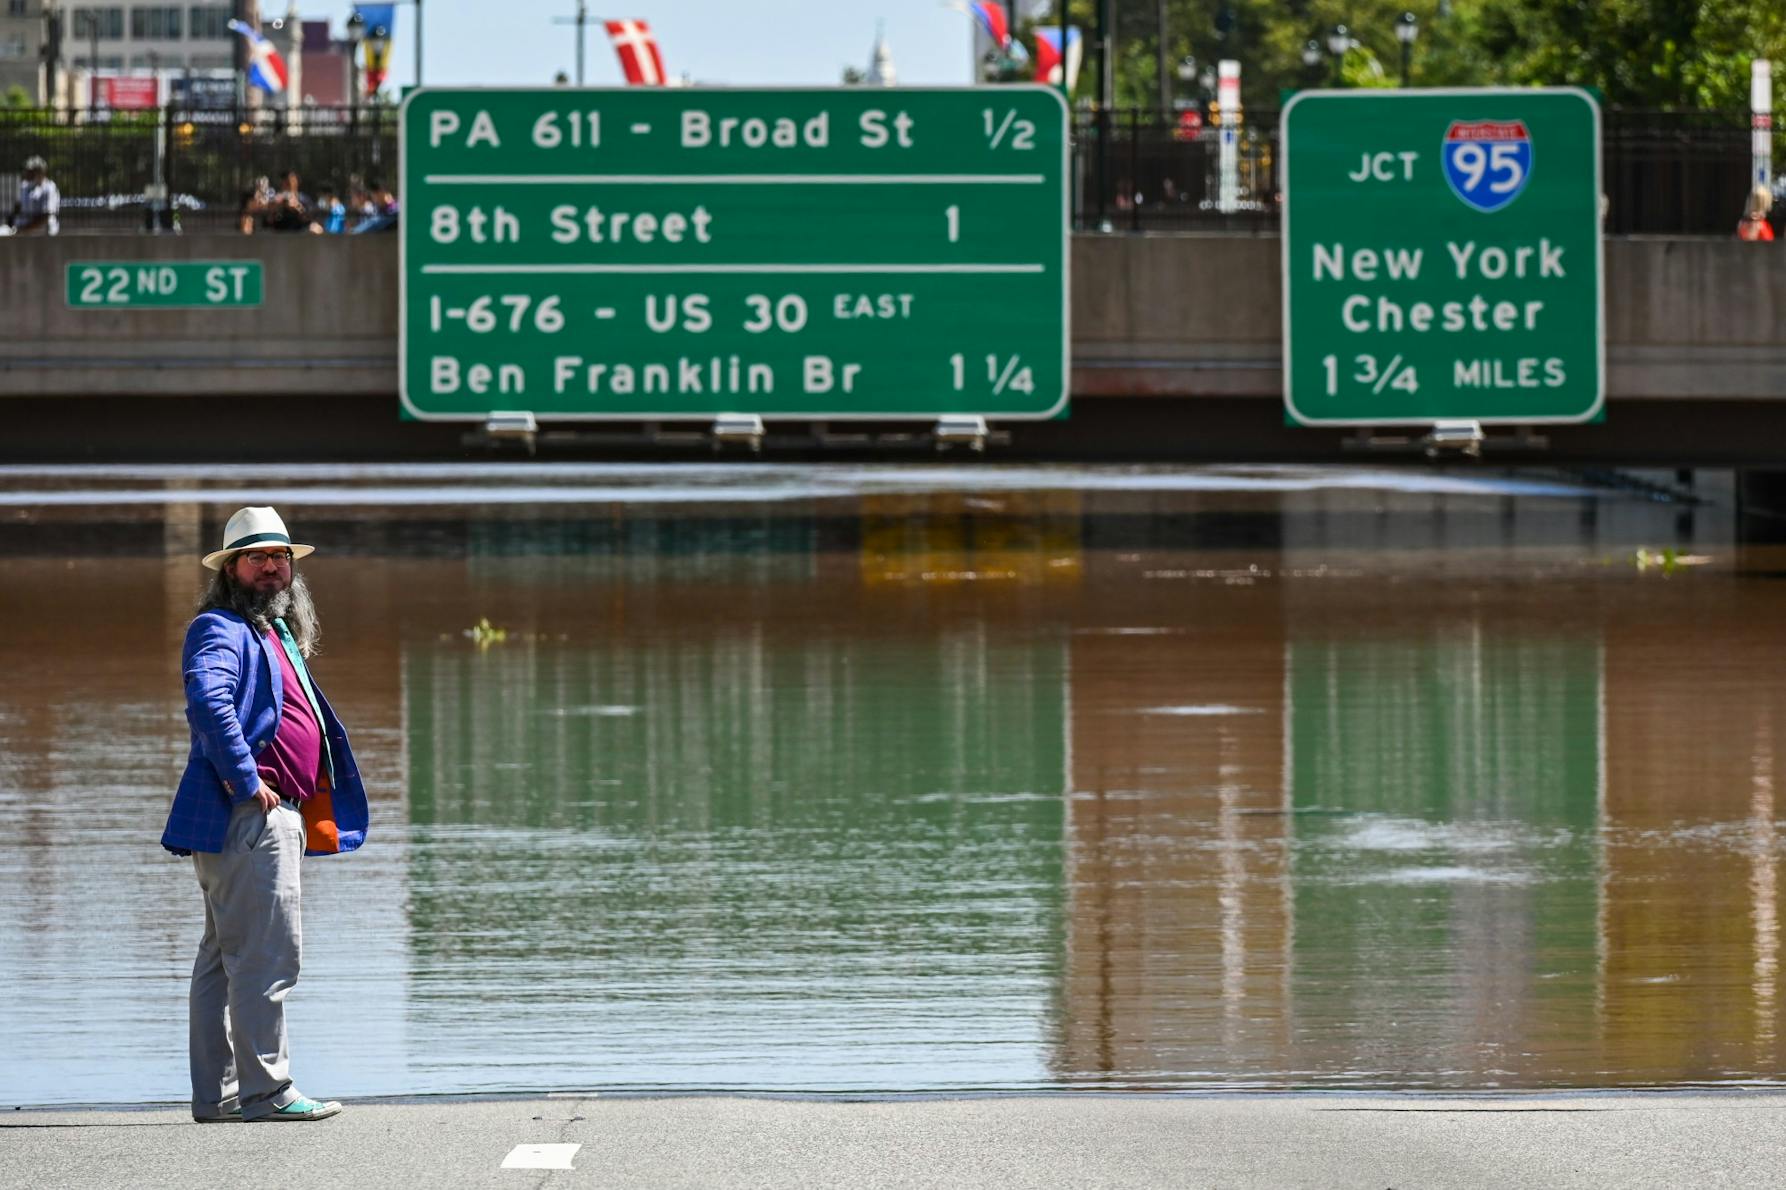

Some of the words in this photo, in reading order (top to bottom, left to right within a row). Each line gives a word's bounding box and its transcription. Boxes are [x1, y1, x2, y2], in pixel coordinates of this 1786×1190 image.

[430, 110, 501, 148] PA
[532, 110, 601, 148] 611
[681, 110, 829, 148] Broad
[859, 109, 914, 148] St
[1348, 151, 1418, 182] JCT
[1452, 143, 1523, 194] 95
[430, 205, 520, 244] 8th
[550, 204, 712, 244] Street
[946, 205, 959, 242] 1
[1313, 243, 1423, 281] New
[1447, 238, 1565, 279] York
[205, 267, 249, 301] ST
[430, 294, 565, 333] I-676
[645, 293, 712, 333] US
[743, 294, 808, 333] 30
[833, 293, 913, 319] EAST
[1342, 294, 1543, 333] Chester
[430, 356, 525, 394] Ben
[554, 355, 774, 394] Franklin
[803, 355, 861, 393] Br
[950, 353, 964, 390] 1
[1323, 354, 1338, 396] 1
[1454, 357, 1566, 388] MILES
